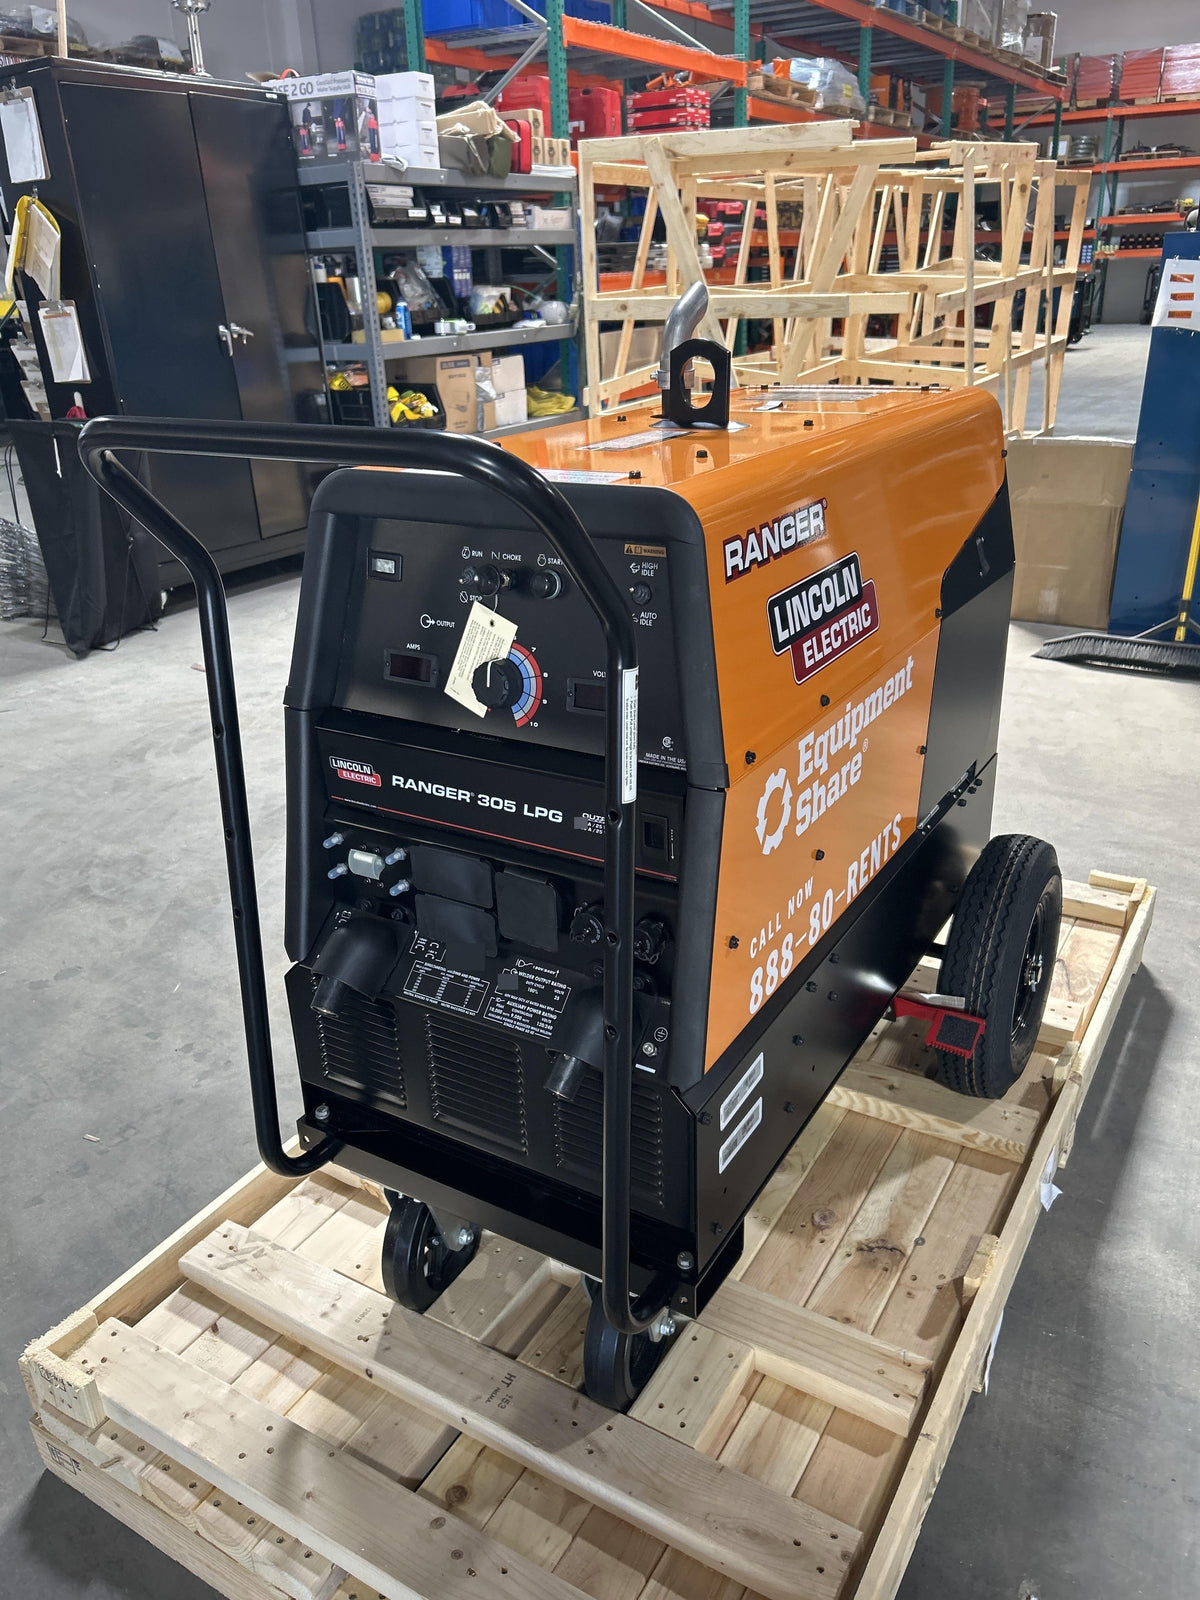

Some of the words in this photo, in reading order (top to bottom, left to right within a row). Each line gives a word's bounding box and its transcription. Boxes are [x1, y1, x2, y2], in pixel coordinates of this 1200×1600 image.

[291, 84, 298, 97] 2
[299, 81, 314, 95] GO
[471, 550, 483, 558] RUN
[502, 553, 522, 562] CHOKE
[641, 562, 659, 570] HIGH
[641, 569, 654, 577] IDLE
[469, 594, 483, 602] STOP
[773, 563, 859, 643] LINCOLN
[640, 611, 658, 620] AUTO
[436, 619, 456, 629] OUTPUT
[802, 602, 872, 669] ELECTRIC
[406, 643, 421, 651] AMPS
[797, 655, 914, 785] Equipment
[645, 752, 660, 760] MADE
[332, 758, 371, 774] LINCOLN
[342, 770, 377, 784] ELECTRIC
[477, 794, 516, 813] 305
[523, 804, 563, 823] LPG
[749, 813, 902, 1015] 888-80-RENTS
[750, 912, 782, 959] CALL
[787, 876, 814, 920] NOW
[519, 971, 535, 980] WELDER
[535, 976, 551, 985] OUTPUT
[551, 981, 567, 990] RATING
[527, 1006, 541, 1015] POWER
[542, 1011, 557, 1020] RATING
[501, 1372, 517, 1388] HT
